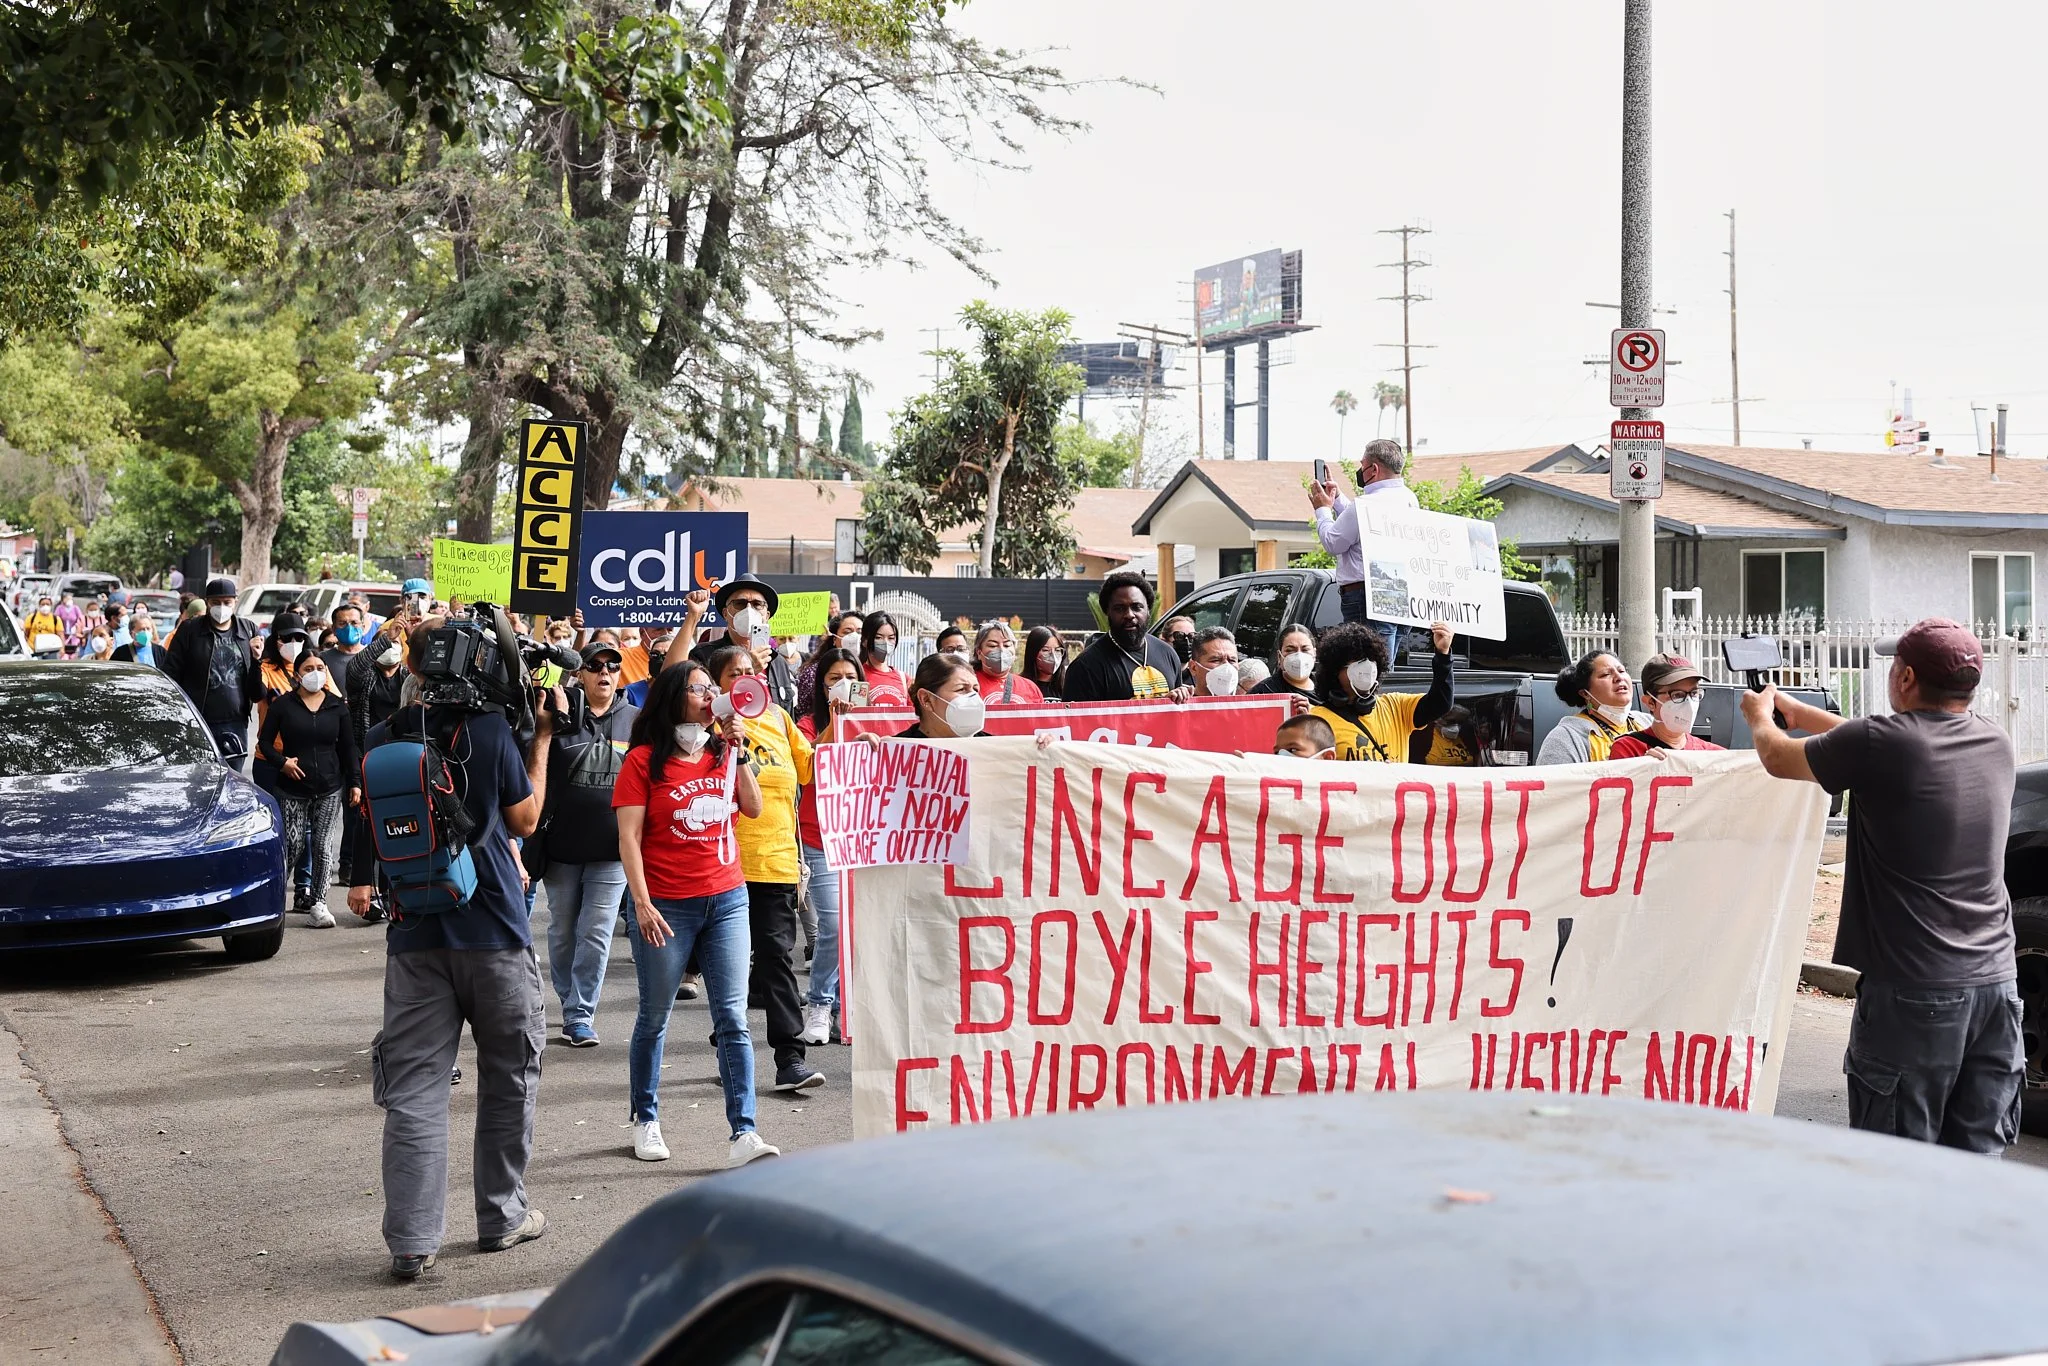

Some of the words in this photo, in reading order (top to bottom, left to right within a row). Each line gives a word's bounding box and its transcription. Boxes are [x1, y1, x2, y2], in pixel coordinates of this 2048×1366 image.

[1613, 374, 1631, 385] 10AM
[1636, 374, 1662, 385] 12NOON
[1614, 425, 1662, 438] WARNING
[1613, 440, 1662, 451] NEIGHBORHOOD
[1627, 451, 1648, 462] WATCH
[526, 425, 576, 590] ACCE
[439, 541, 512, 571] Lineage
[590, 530, 737, 593] cdlu
[496, 564, 510, 575] un
[1409, 556, 1448, 578] OUT
[436, 573, 472, 587] estudio
[449, 587, 497, 601] Ambiental
[589, 595, 635, 609] Consejo
[636, 595, 654, 607] De
[655, 595, 688, 606] Latino
[779, 594, 822, 614] eage
[617, 611, 717, 624] 1-800-474-76
[773, 612, 794, 620] uera
[1409, 596, 1482, 625] COMMUNITY
[815, 742, 971, 797] ENVIRONMENTAL
[669, 777, 734, 802] EASTSID
[817, 785, 896, 836] JUSTICE
[900, 790, 970, 834] NOW
[386, 820, 418, 837] LiveU
[824, 830, 880, 867] LINEAGE
[886, 829, 953, 864] OUT!!!
[1391, 780, 1545, 904] OUT
[1579, 776, 1693, 898] OF
[954, 908, 1221, 1034] BOYLE
